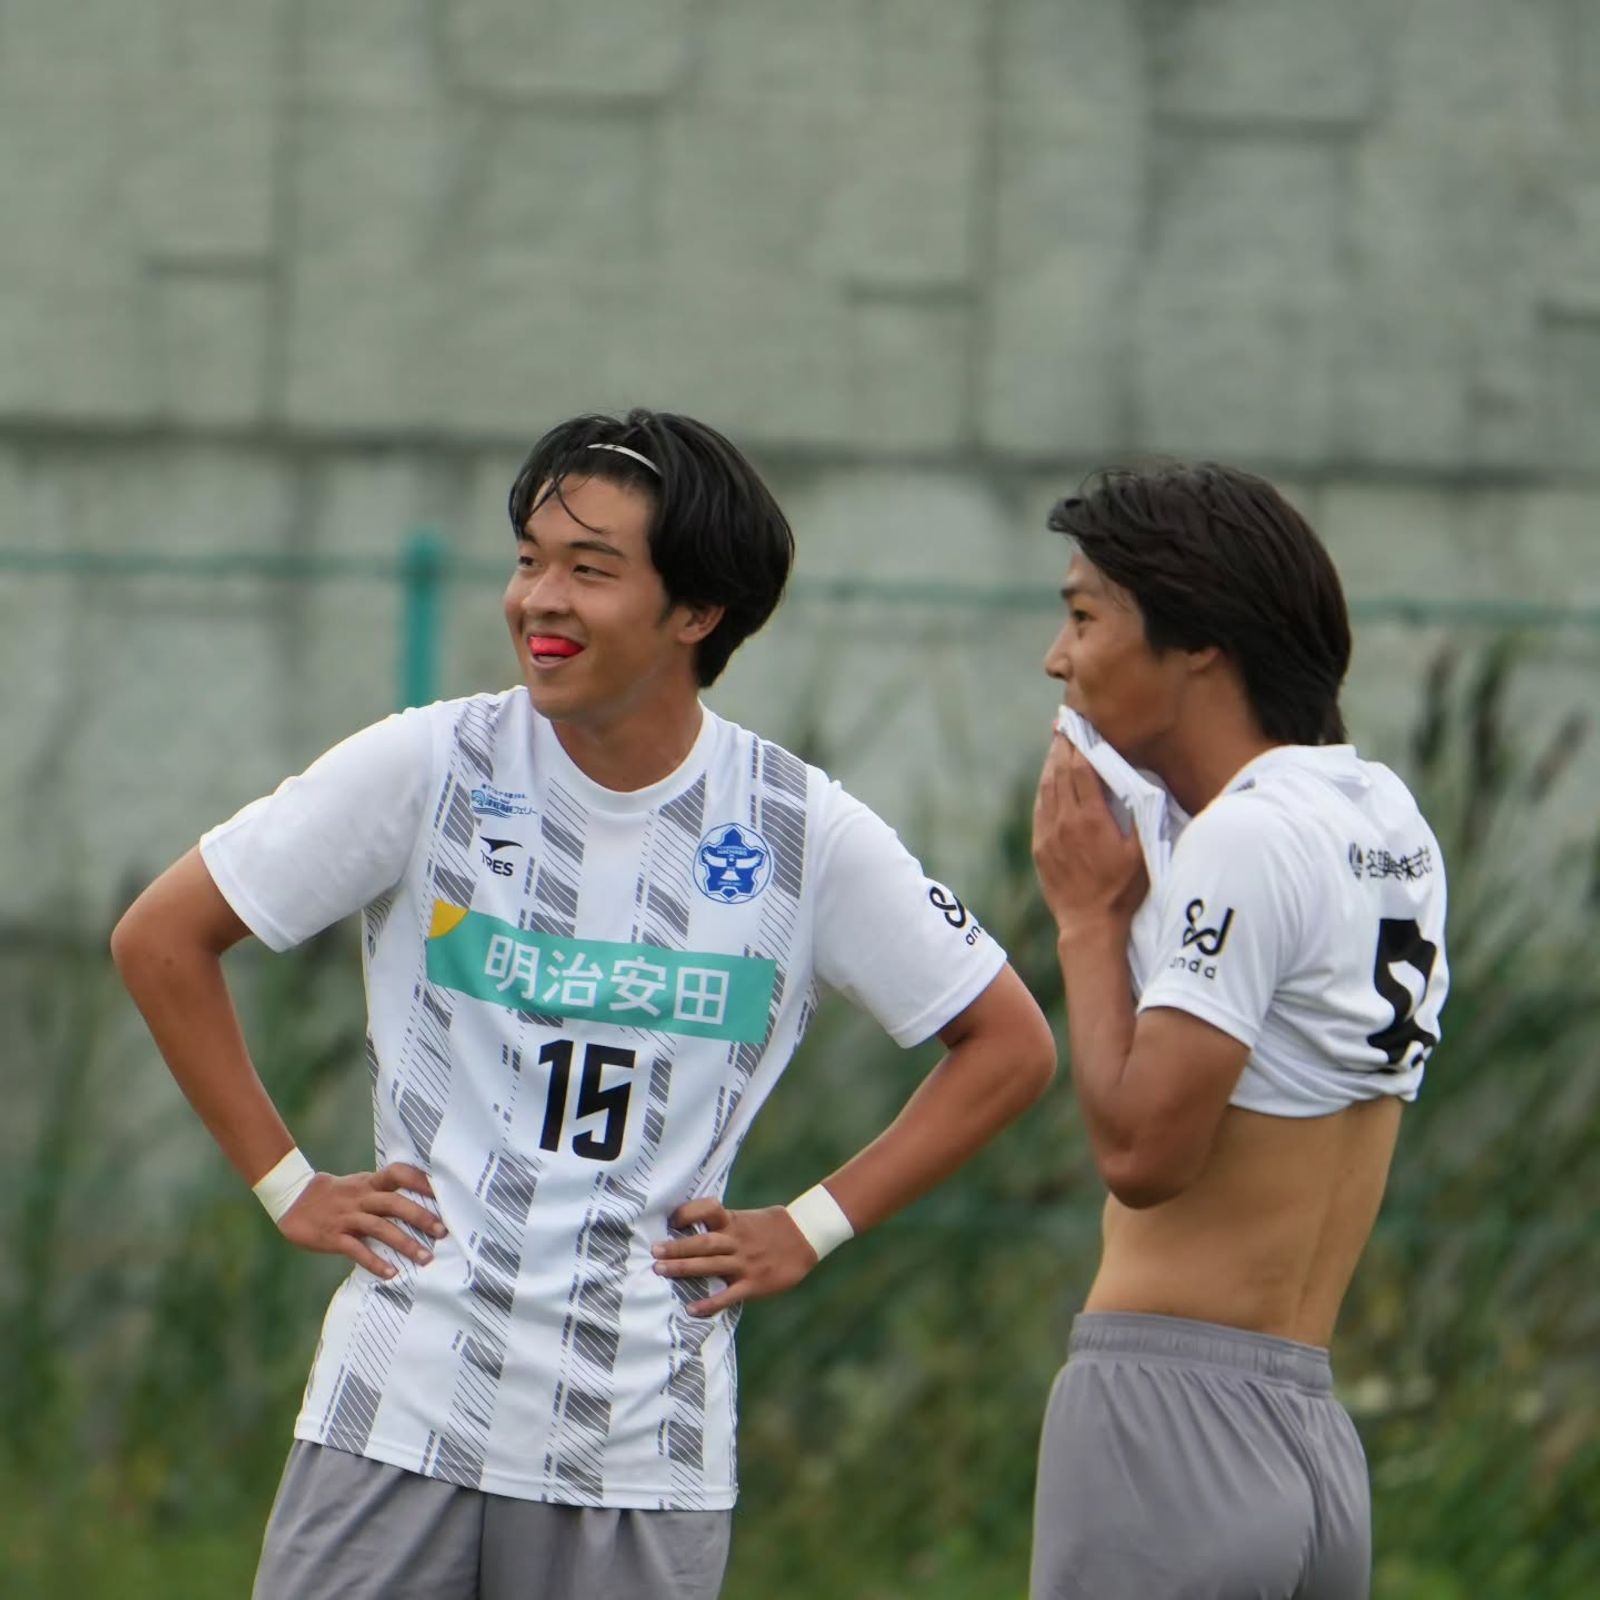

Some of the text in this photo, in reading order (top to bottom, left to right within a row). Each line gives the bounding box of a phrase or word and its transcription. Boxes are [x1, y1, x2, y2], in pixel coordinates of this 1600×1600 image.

[484, 934, 730, 1025] 明治安田
[538, 1039, 636, 1162] 15
